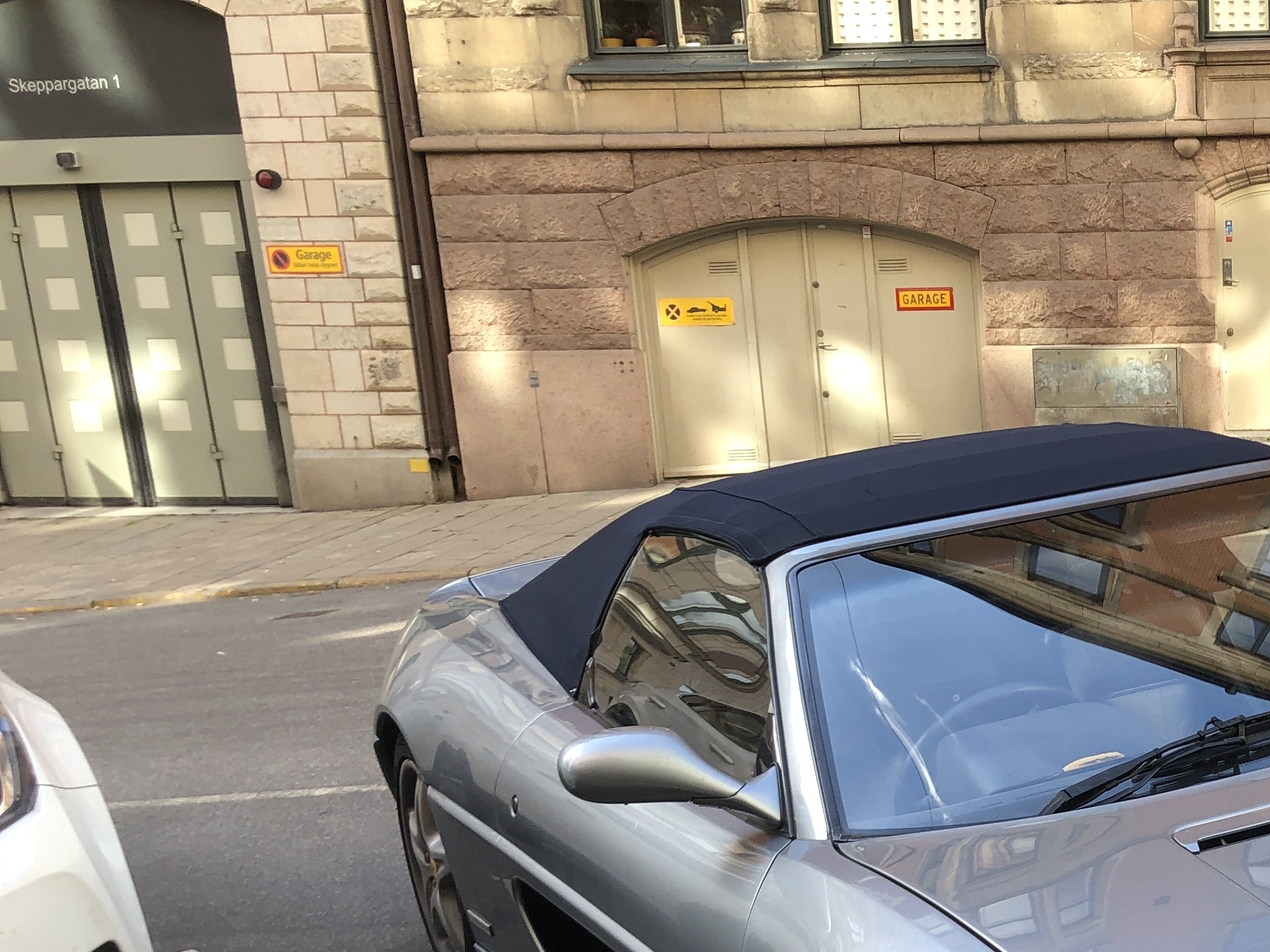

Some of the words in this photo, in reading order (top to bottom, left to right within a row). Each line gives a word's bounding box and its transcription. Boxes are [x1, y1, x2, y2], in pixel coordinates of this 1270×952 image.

[8, 76, 108, 95] Skeppargatan
[112, 73, 120, 89] 1
[295, 249, 332, 262] Garage
[902, 293, 948, 305] GARAGE
